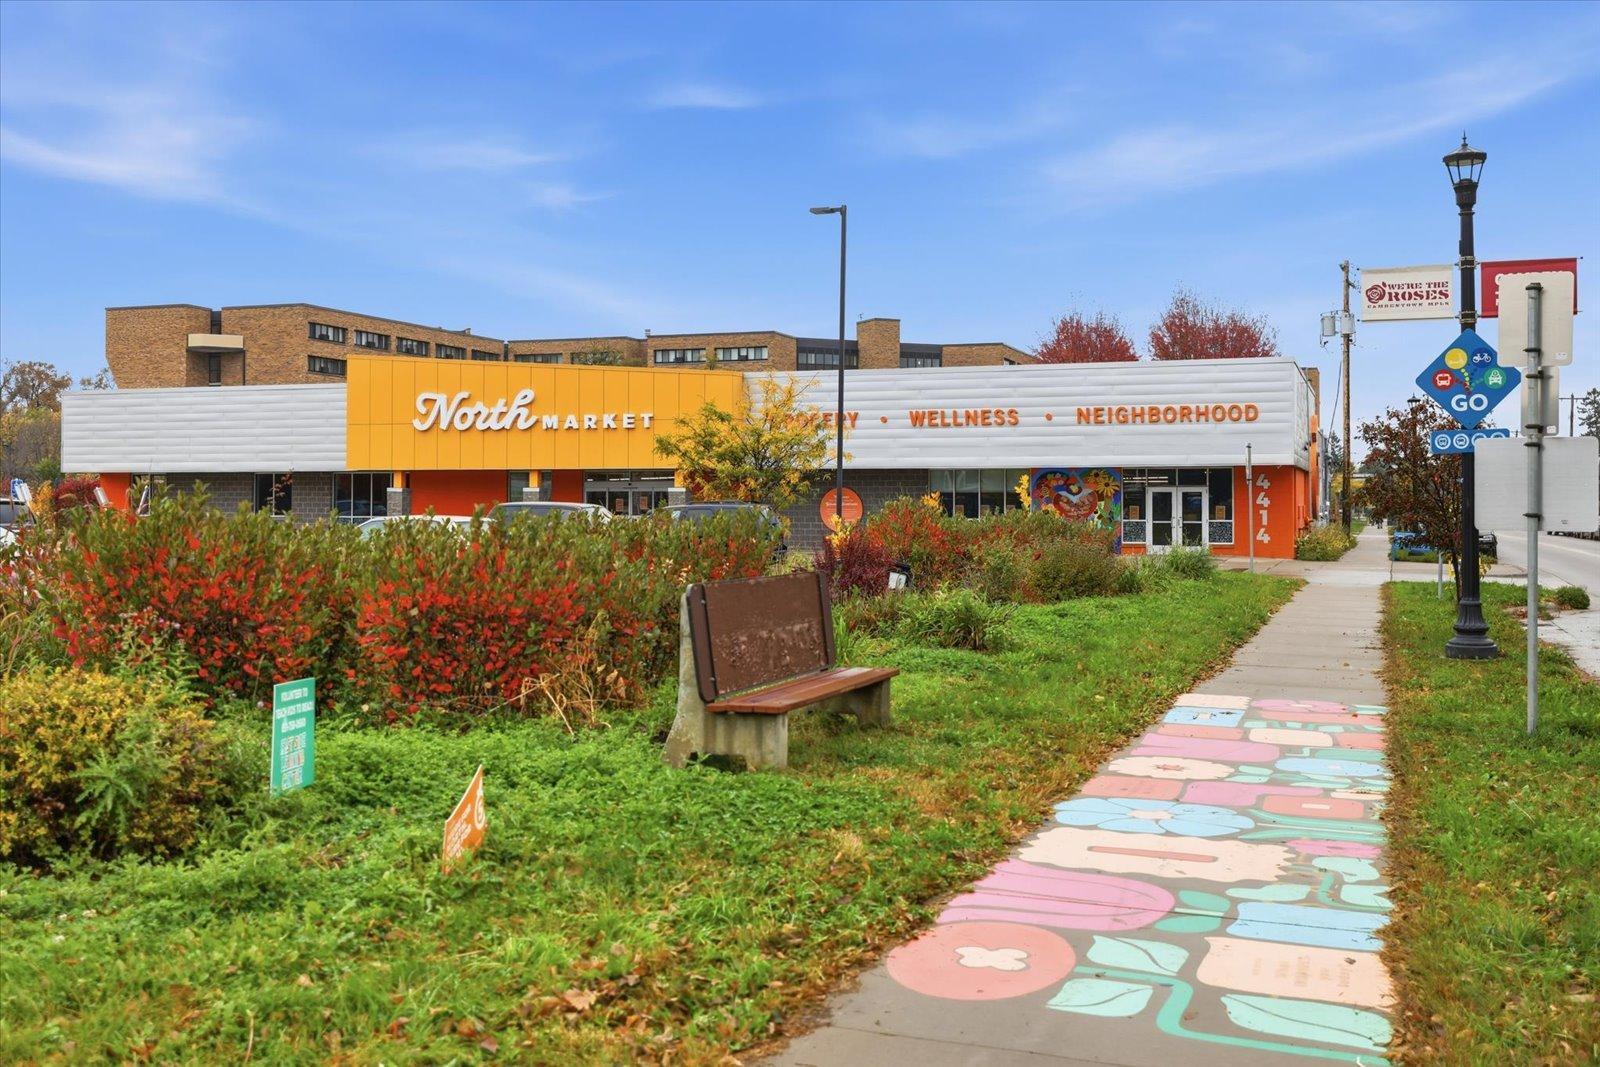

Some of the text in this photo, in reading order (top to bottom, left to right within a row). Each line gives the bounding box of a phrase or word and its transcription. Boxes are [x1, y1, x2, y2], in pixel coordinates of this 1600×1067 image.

[1387, 281, 1449, 290] WE'RE THE
[1387, 289, 1450, 302] ROSES
[412, 388, 654, 431] North MARKET
[1451, 393, 1489, 412] GO
[909, 408, 1019, 427] WELLNESS
[1076, 403, 1260, 424] NEIGHBORHOOD
[1256, 473, 1271, 544] 4414
